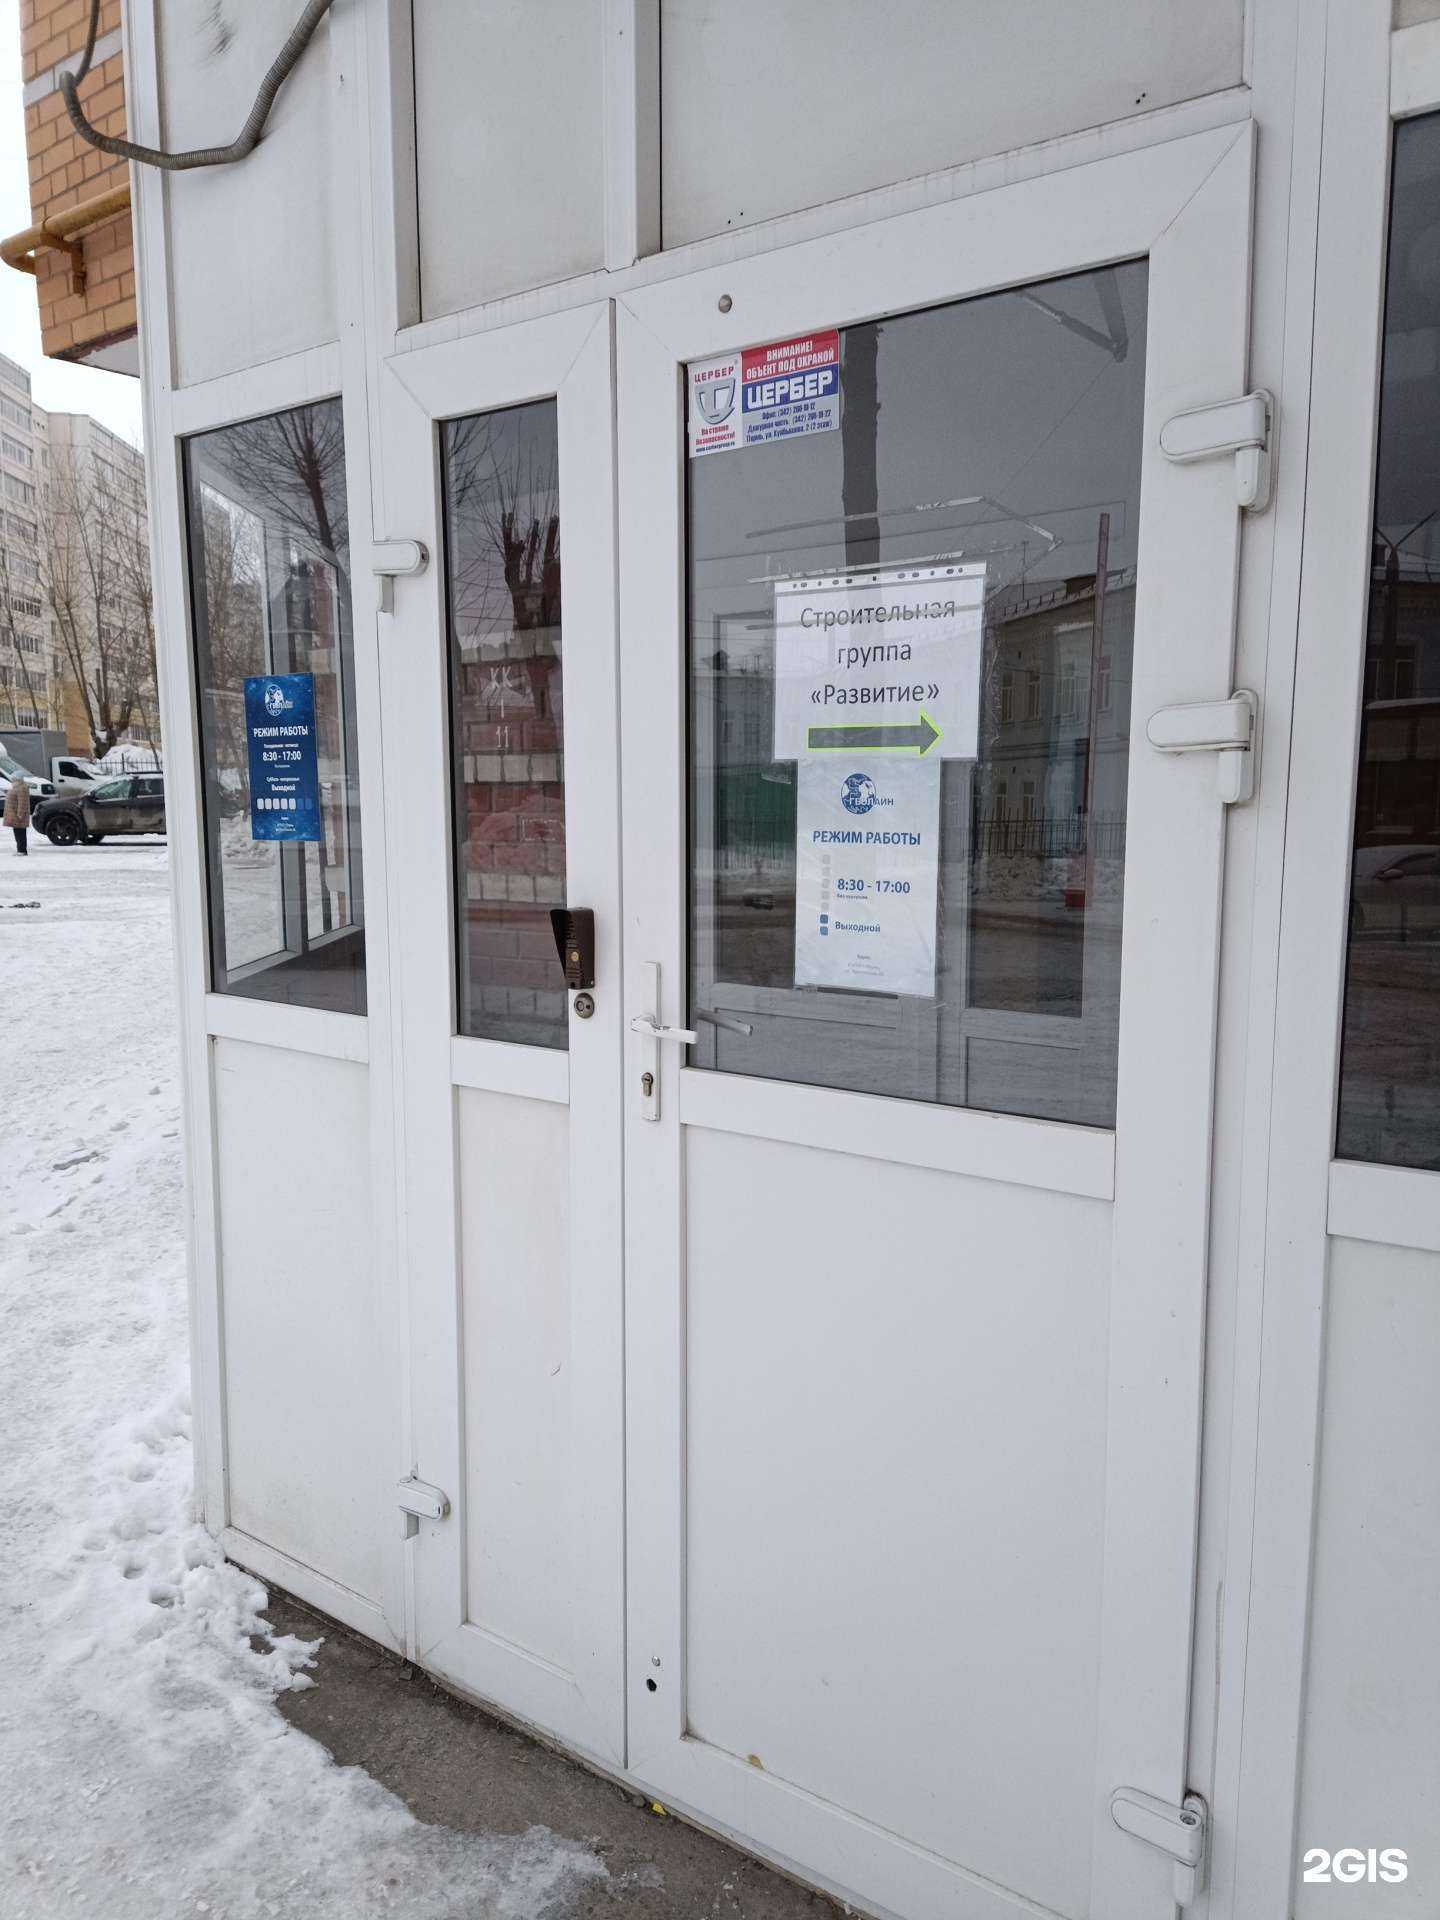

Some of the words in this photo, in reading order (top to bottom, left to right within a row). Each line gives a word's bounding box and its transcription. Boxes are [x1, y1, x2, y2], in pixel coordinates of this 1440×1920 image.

[767, 341, 813, 361] ВНИМАНИЕ!
[746, 363, 777, 380] ОБЪЕКТ
[778, 359, 797, 373] ПОД
[797, 347, 834, 369] ОХРАНОЙ
[694, 366, 734, 383] ЦЕРБЕР
[747, 370, 833, 410] ЦЕРБЕР
[800, 600, 956, 632] Строительная
[837, 643, 912, 669] группа
[811, 682, 940, 705] «Развитие»
[253, 726, 279, 738] РЕЖИМ
[279, 725, 308, 737] РАБОТЫ
[262, 751, 278, 761] 8:30
[282, 750, 302, 761] 17:00
[812, 830, 863, 844] РЕЖИМ
[866, 831, 921, 846] РАБОТЫ
[837, 878, 865, 891] 8:30
[875, 880, 911, 894] 17:00
[835, 921, 881, 933] Выходной
